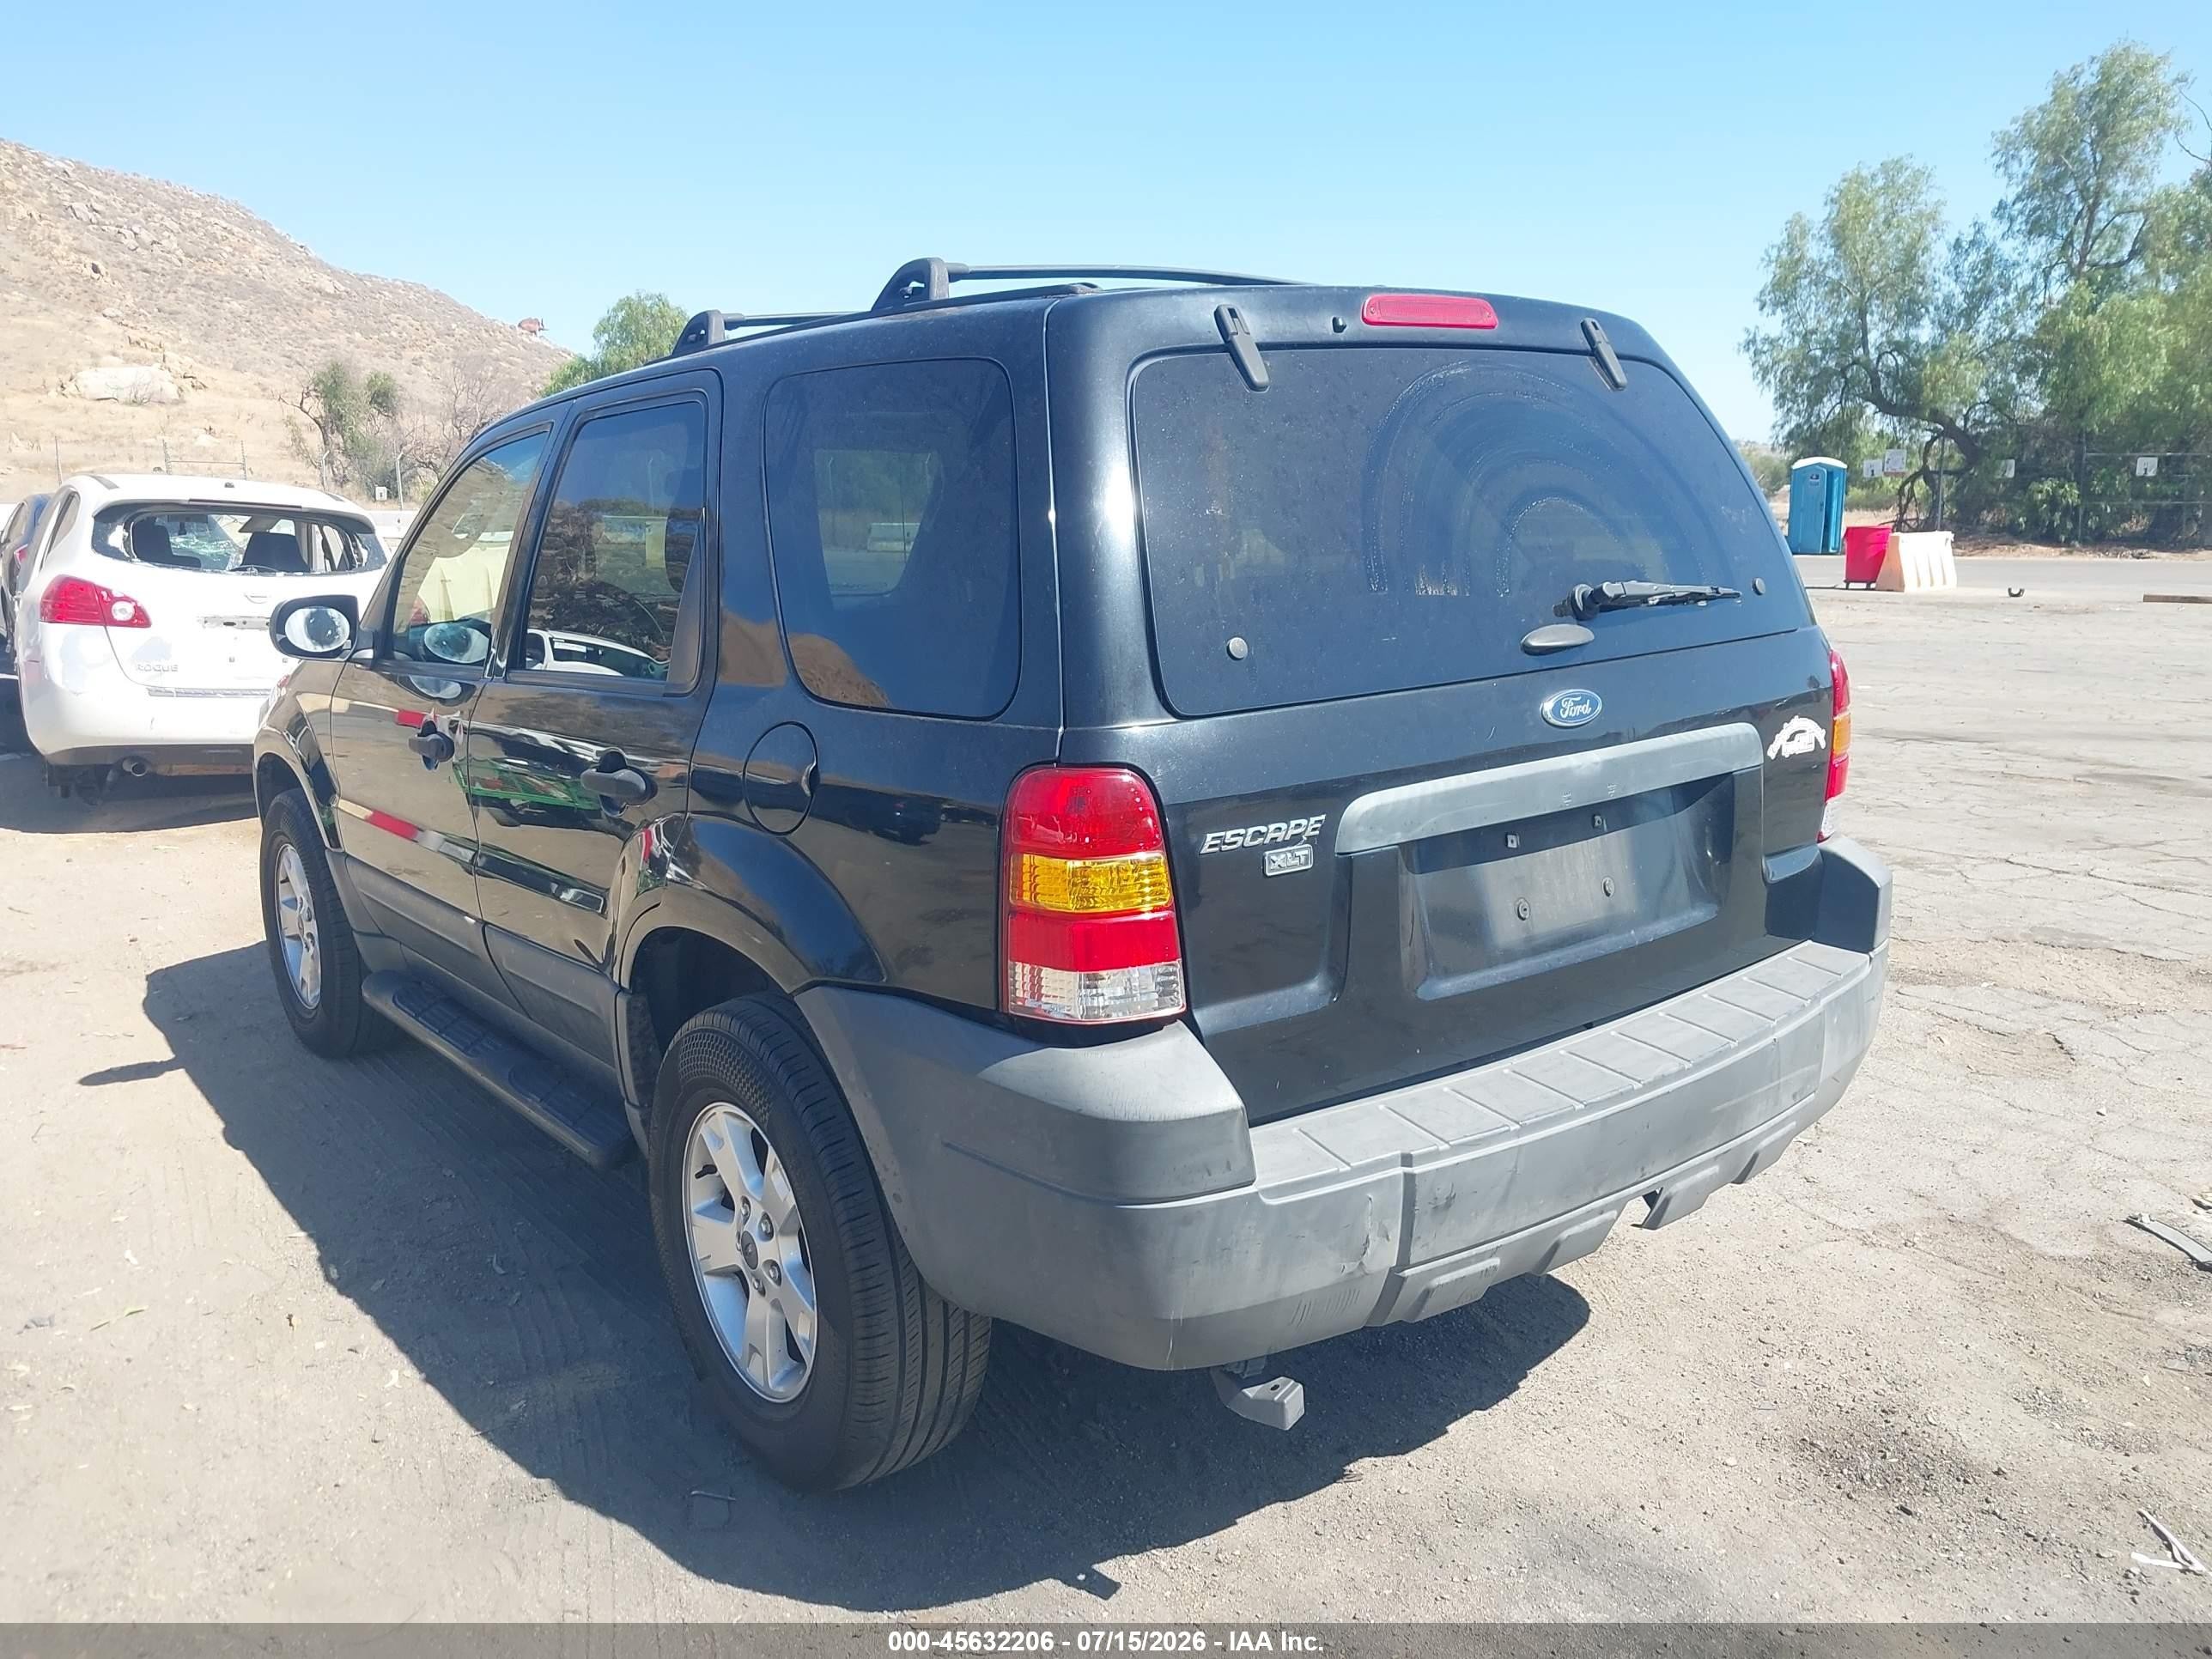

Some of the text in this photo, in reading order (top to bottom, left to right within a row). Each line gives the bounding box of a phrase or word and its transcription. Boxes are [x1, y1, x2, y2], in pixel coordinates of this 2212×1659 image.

[1559, 696, 1592, 719] Ford
[1200, 814, 1327, 854] ESCAPE
[1269, 849, 1310, 871] XLT
